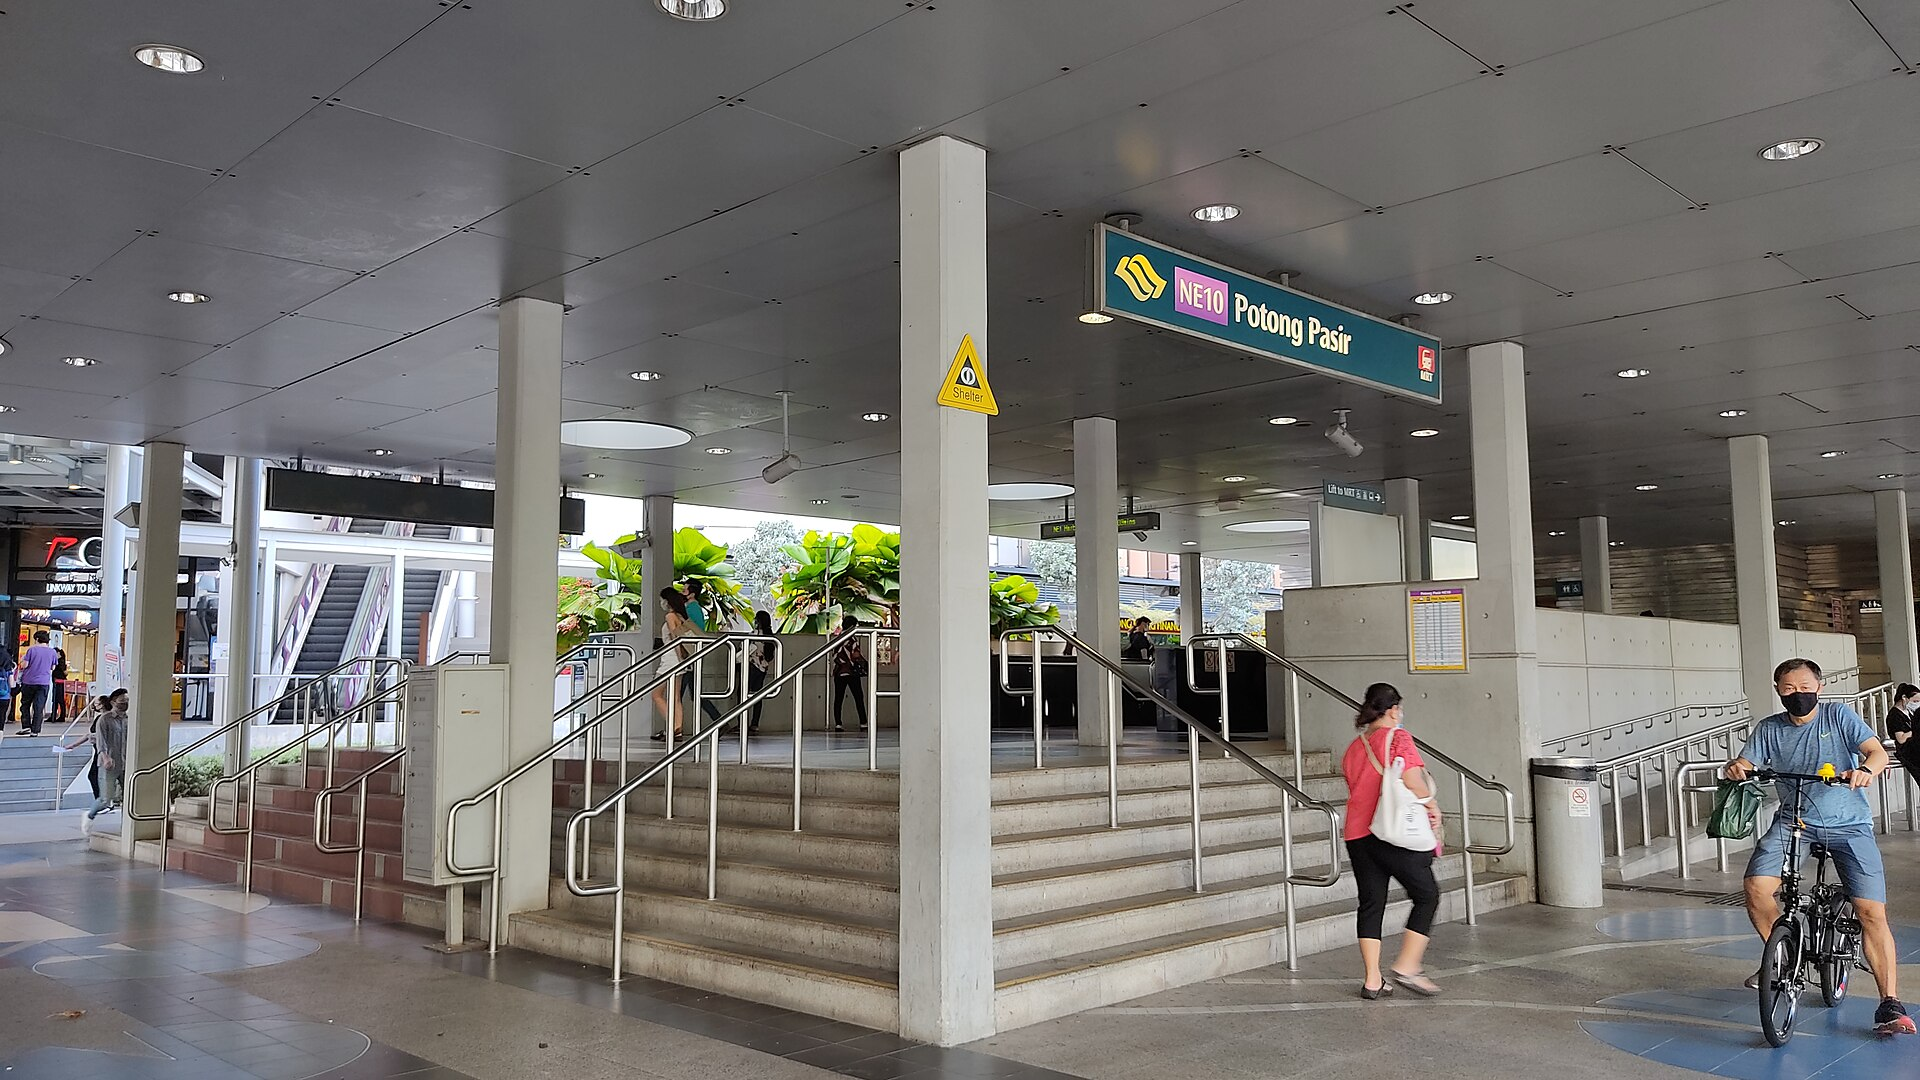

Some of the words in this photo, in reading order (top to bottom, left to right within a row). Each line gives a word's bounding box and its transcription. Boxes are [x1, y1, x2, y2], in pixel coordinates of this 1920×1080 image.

[1179, 278, 1225, 316] NE10
[1234, 292, 1304, 347] Potong
[1308, 316, 1353, 356] Pasir
[953, 386, 984, 403] Shelter
[1328, 483, 1337, 495] Lift
[1338, 486, 1343, 495] to
[1344, 487, 1355, 498] MRT
[46, 583, 76, 594] LINKWAY
[76, 583, 87, 594] TO
[1159, 621, 1182, 632] FINANC
